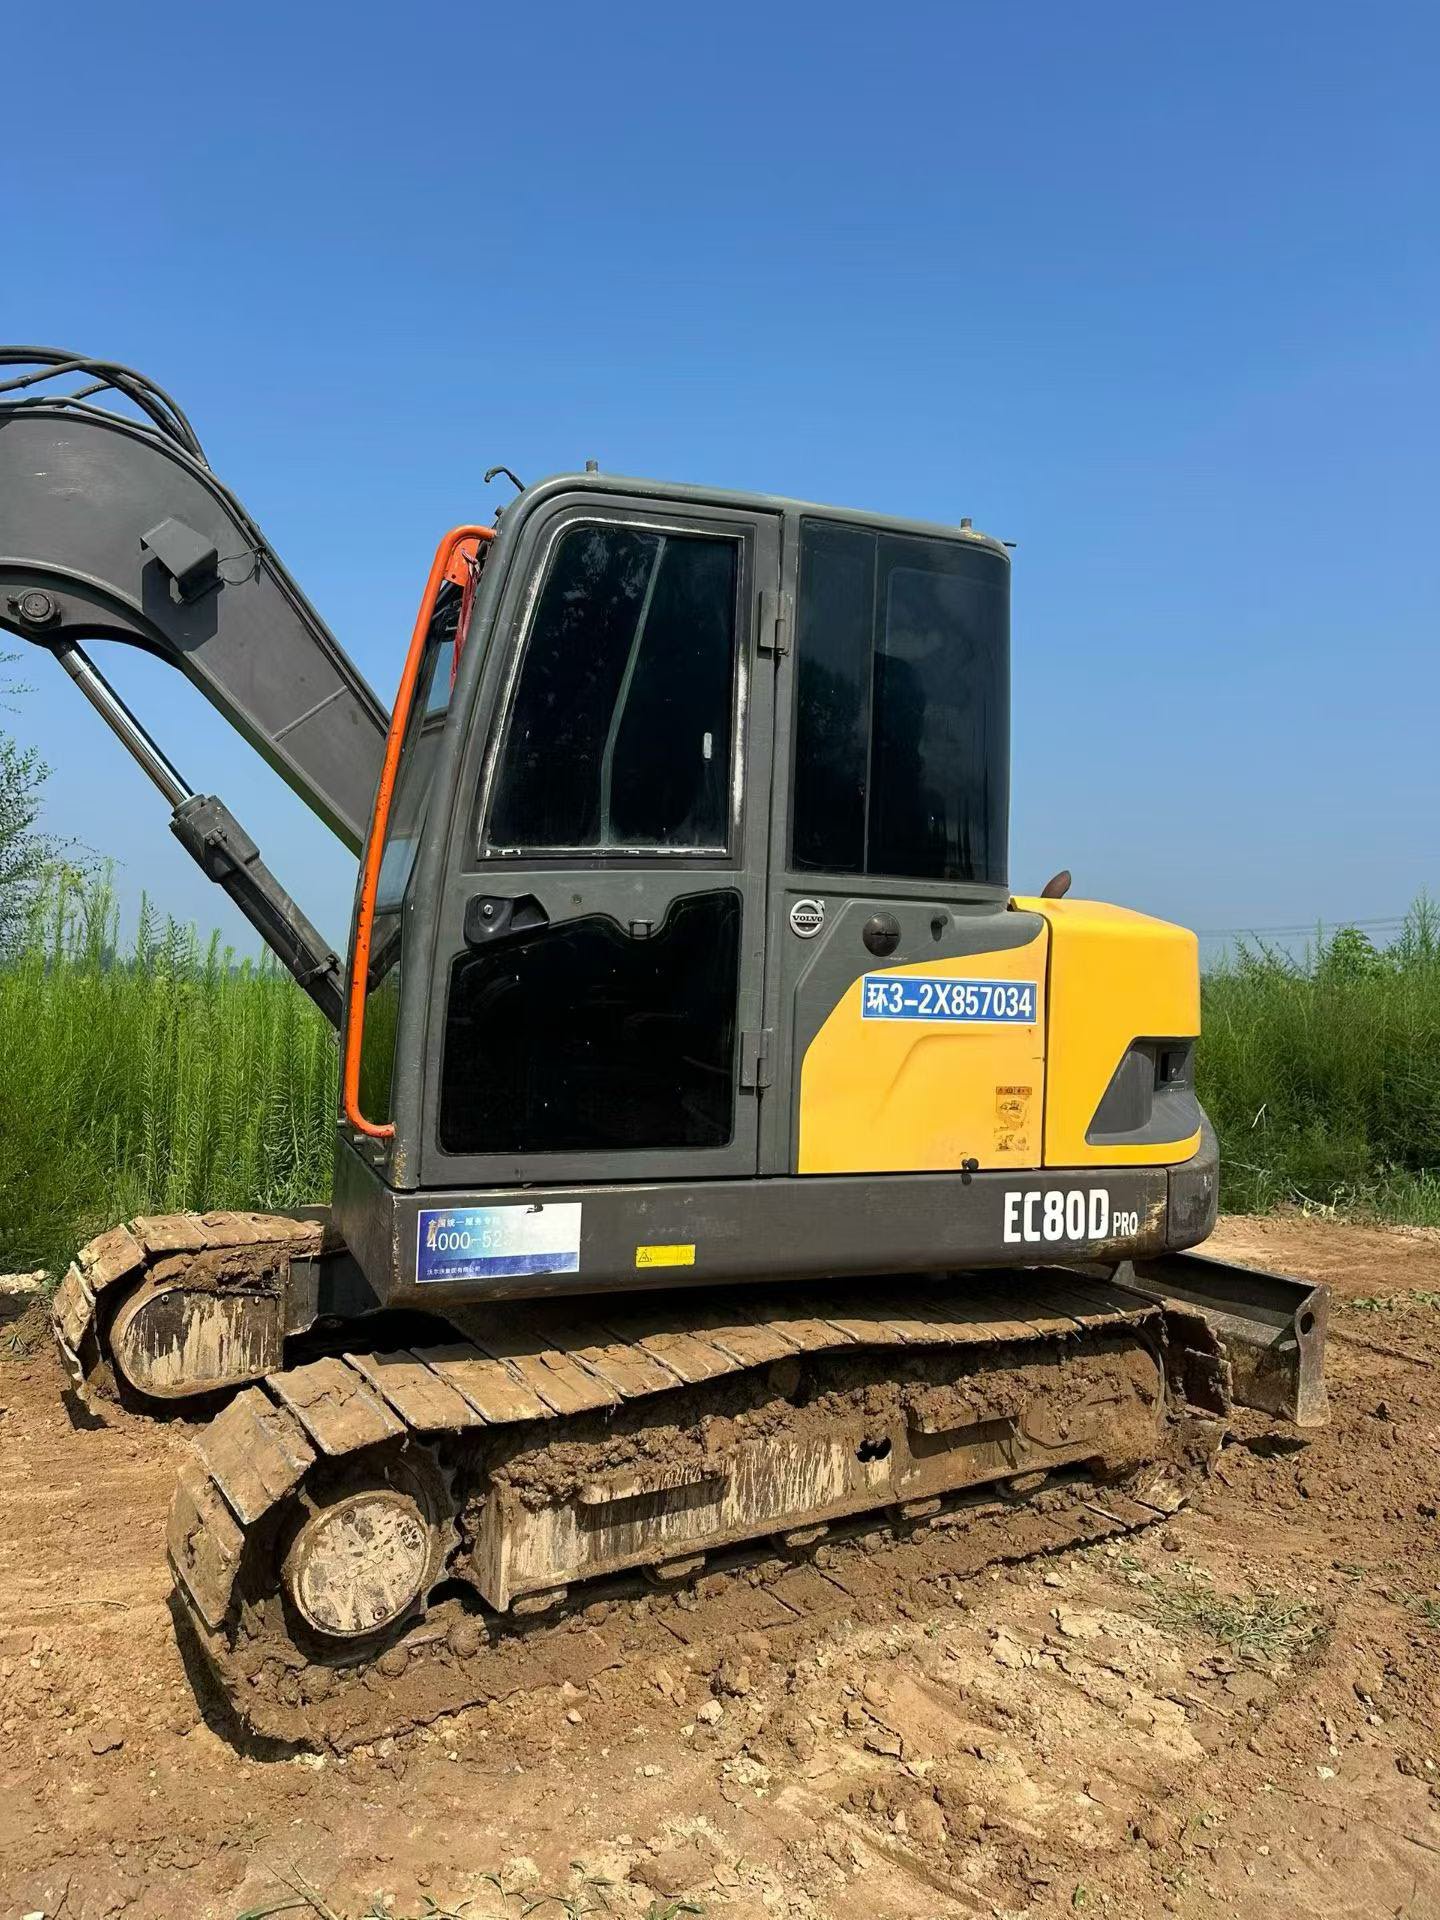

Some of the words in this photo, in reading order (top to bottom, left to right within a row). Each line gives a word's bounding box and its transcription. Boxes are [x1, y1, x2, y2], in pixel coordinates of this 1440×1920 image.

[866, 982, 1033, 1017] 环3-2X857034
[1003, 1188, 1110, 1243] EC80D
[1112, 1211, 1139, 1237] PRO
